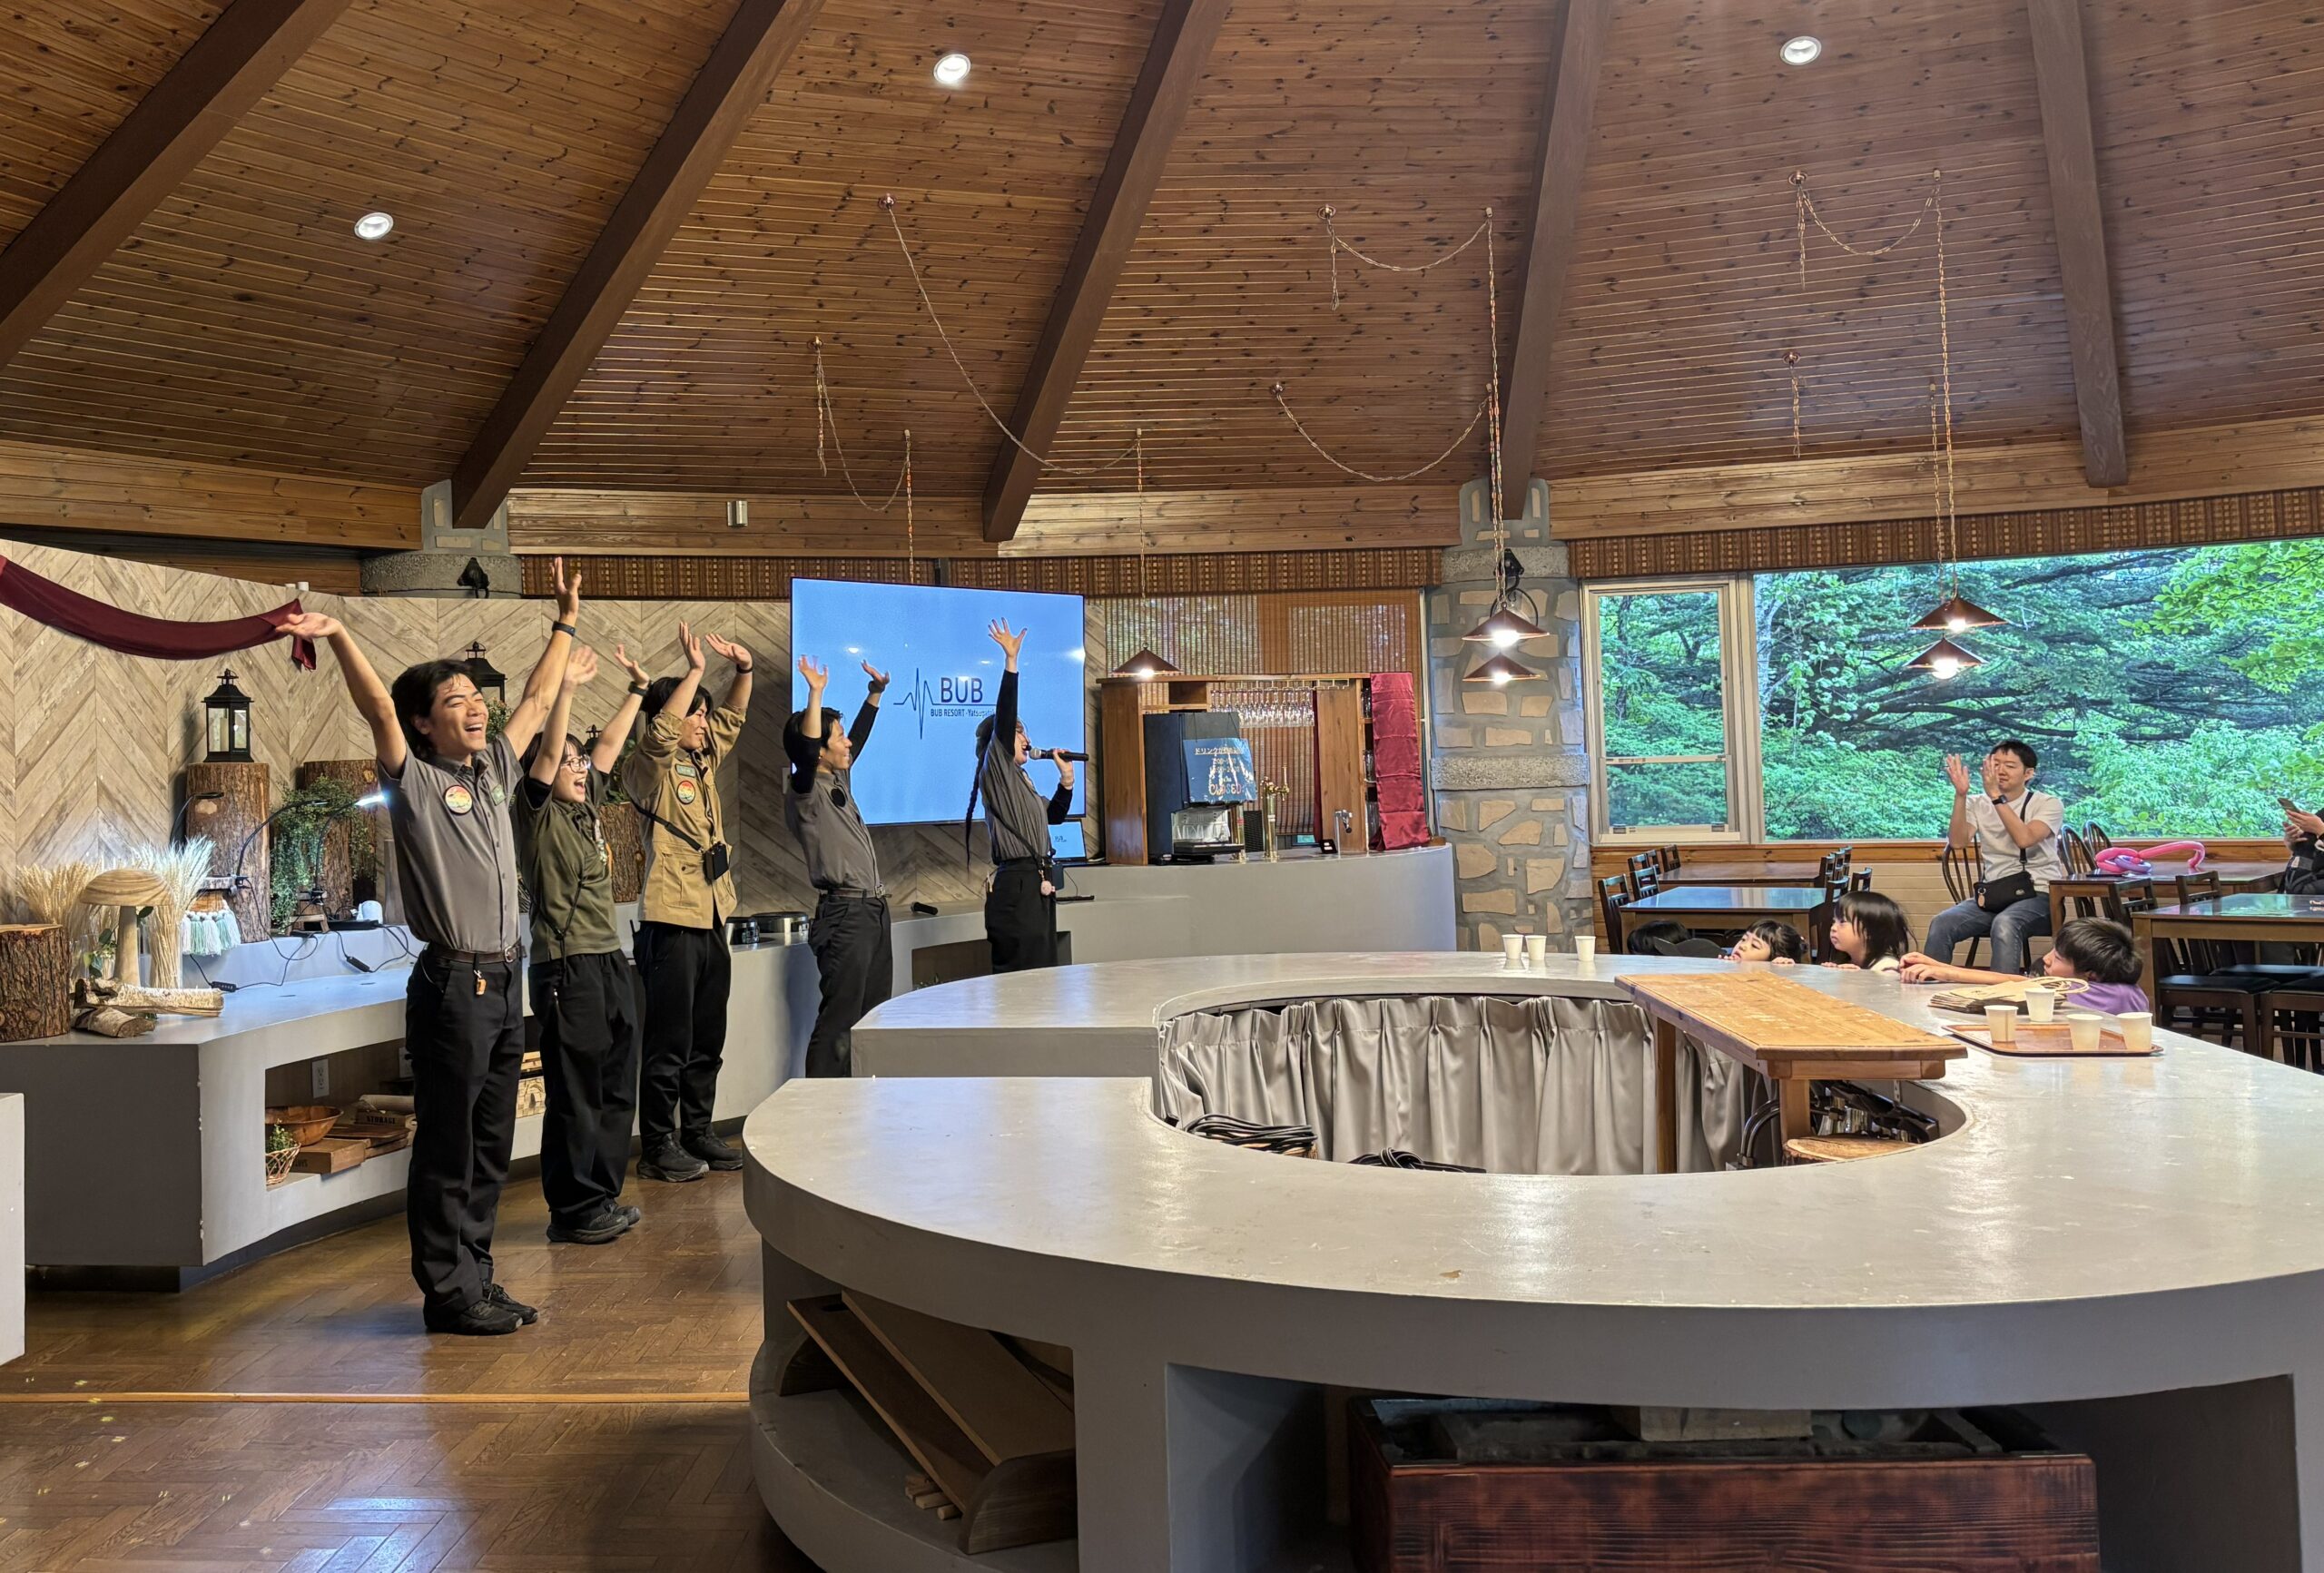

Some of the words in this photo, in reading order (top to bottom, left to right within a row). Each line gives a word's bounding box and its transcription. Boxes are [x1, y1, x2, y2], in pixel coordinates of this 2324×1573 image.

[940, 677, 983, 703] BUB
[931, 708, 943, 717] BUB
[944, 708, 965, 717] RESORT
